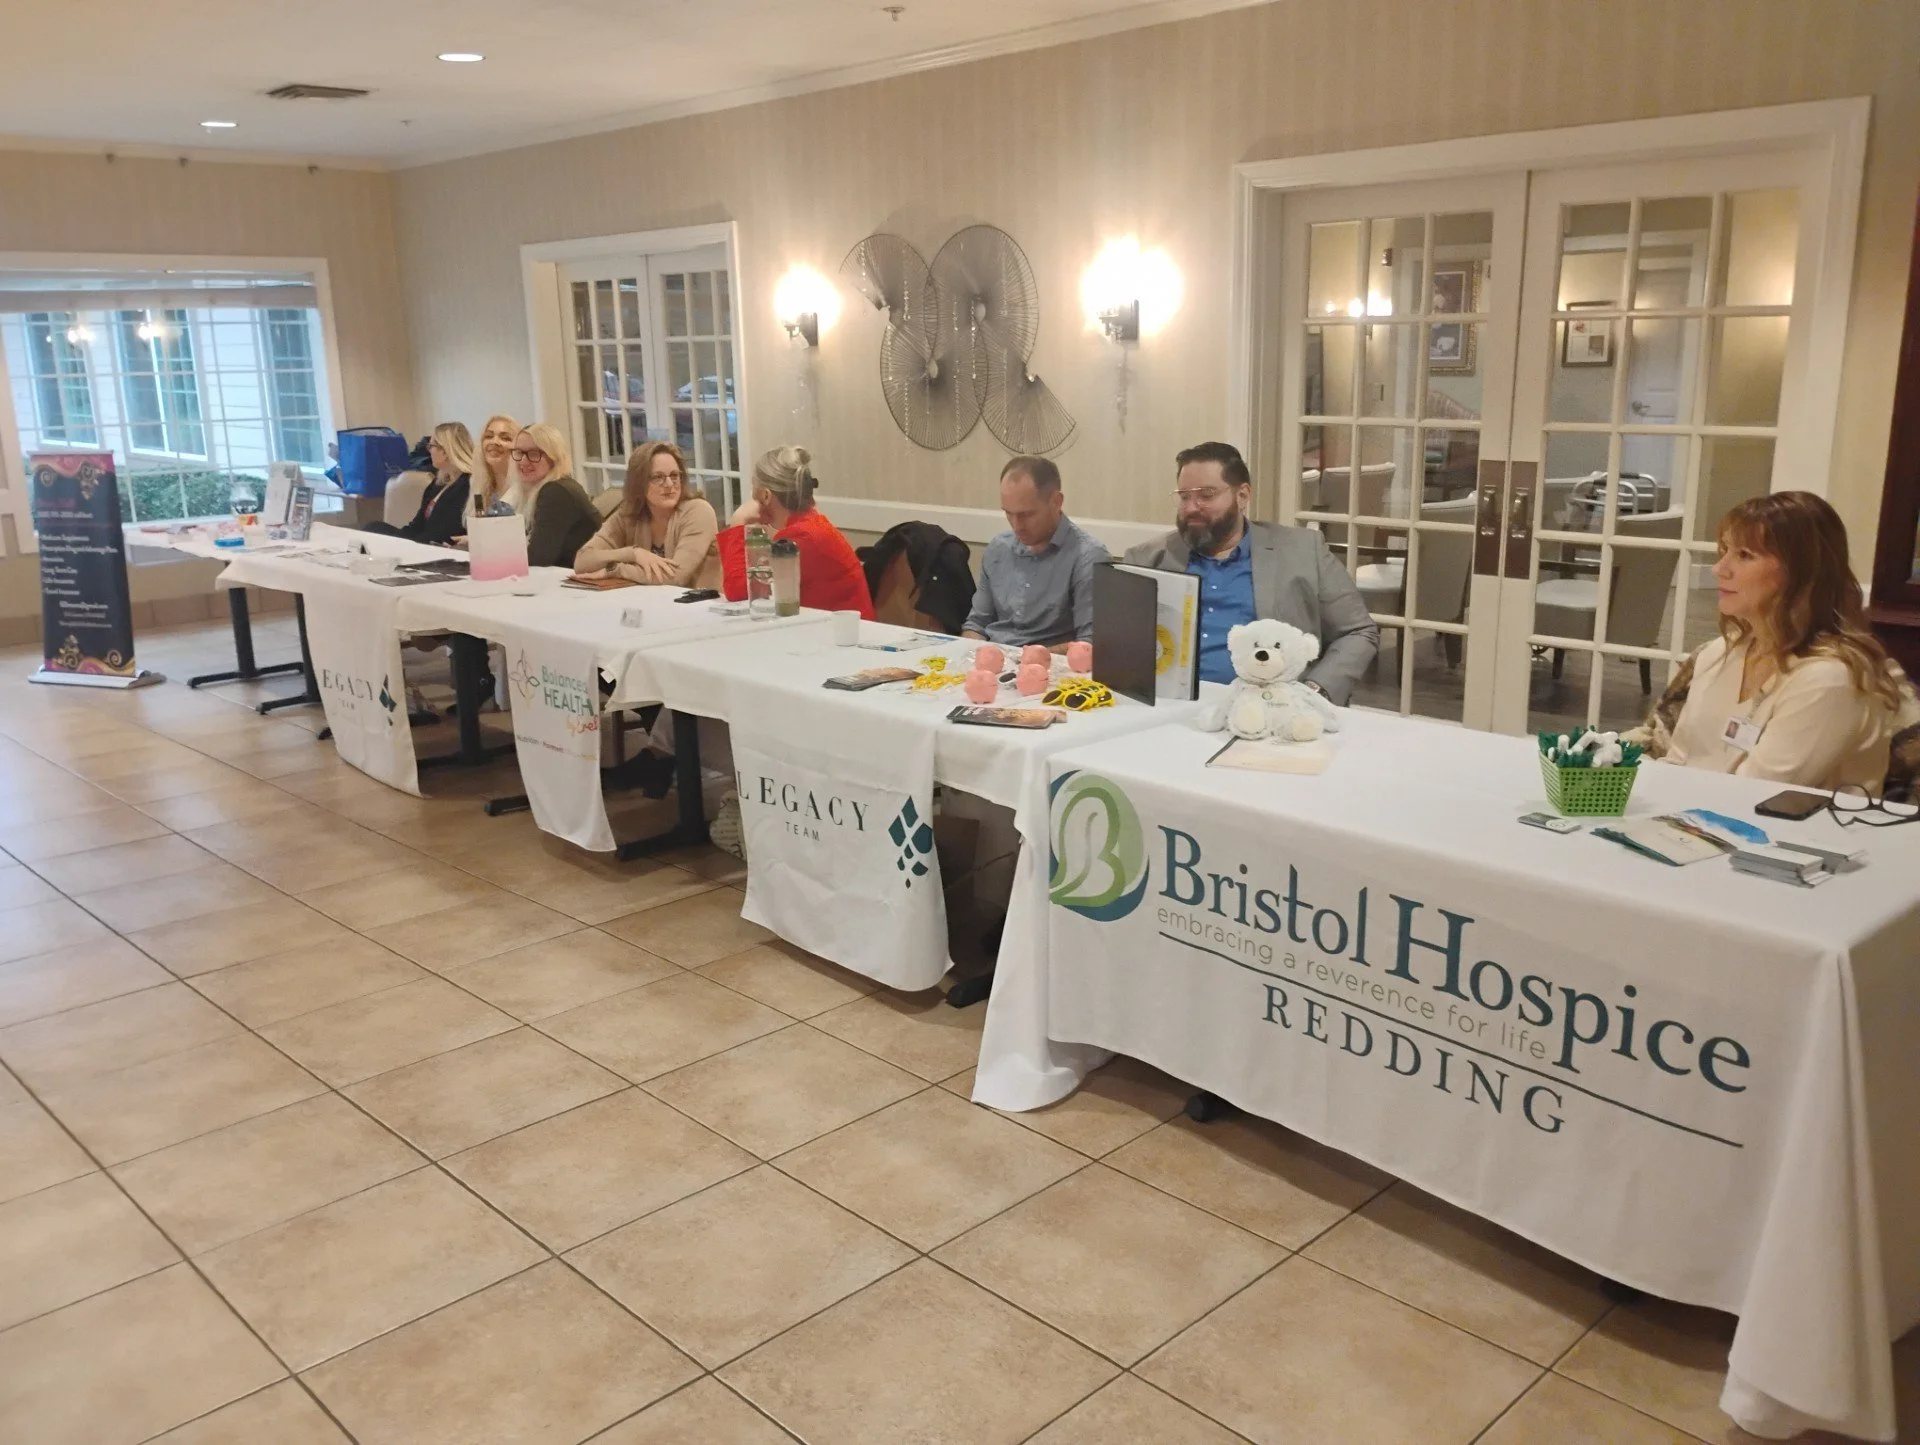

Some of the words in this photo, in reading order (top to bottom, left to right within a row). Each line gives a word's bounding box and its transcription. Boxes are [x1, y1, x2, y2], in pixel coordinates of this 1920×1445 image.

[543, 686, 594, 717] HEALTH
[736, 770, 869, 832] LEGACY
[785, 820, 820, 842] TEAM
[1157, 824, 1371, 968] Bristol
[1384, 893, 1751, 1094] Hospice
[1157, 905, 1273, 965] embracing
[1283, 951, 1297, 970] a
[1306, 957, 1436, 1020] reverence
[1447, 1004, 1488, 1038] for
[1501, 1021, 1546, 1060] life
[1262, 983, 1566, 1134] REDDING
